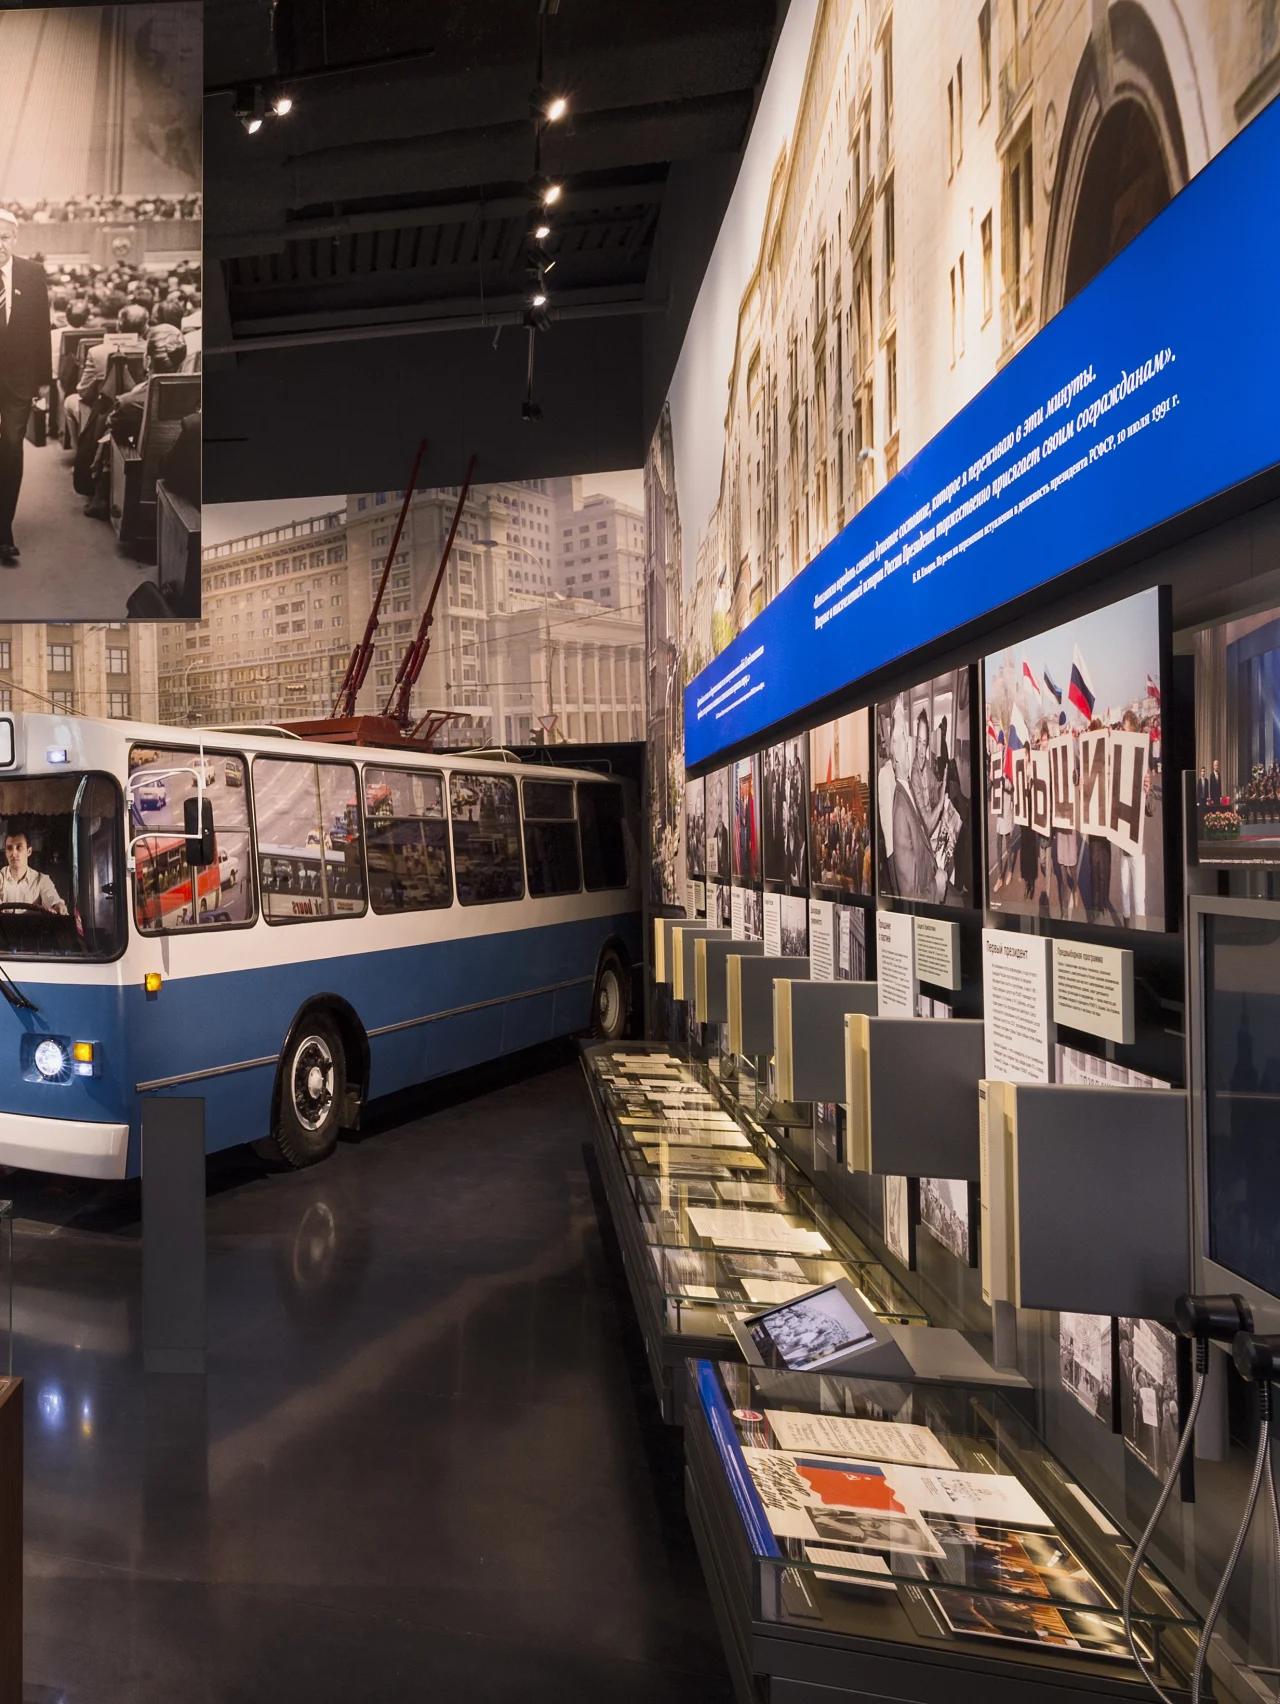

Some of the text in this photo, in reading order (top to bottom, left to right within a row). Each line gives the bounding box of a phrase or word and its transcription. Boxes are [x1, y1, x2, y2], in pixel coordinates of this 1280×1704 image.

[961, 471, 968, 488] я
[968, 431, 1015, 482] переживаю
[1015, 425, 1022, 443] в
[1023, 406, 1044, 437] эти
[1045, 364, 1097, 419] минуты.
[992, 446, 1041, 499] присягает
[1042, 420, 1075, 458] своим
[1076, 347, 1176, 428] согражданам».
[1050, 456, 1089, 492] президента
[1089, 434, 1116, 464] РСФСР,
[1117, 428, 1126, 445] 10
[1127, 413, 1151, 438] июля
[1152, 397, 1170, 423] 1991
[1172, 393, 1180, 409] г.
[986, 940, 1029, 960] Первый президент
